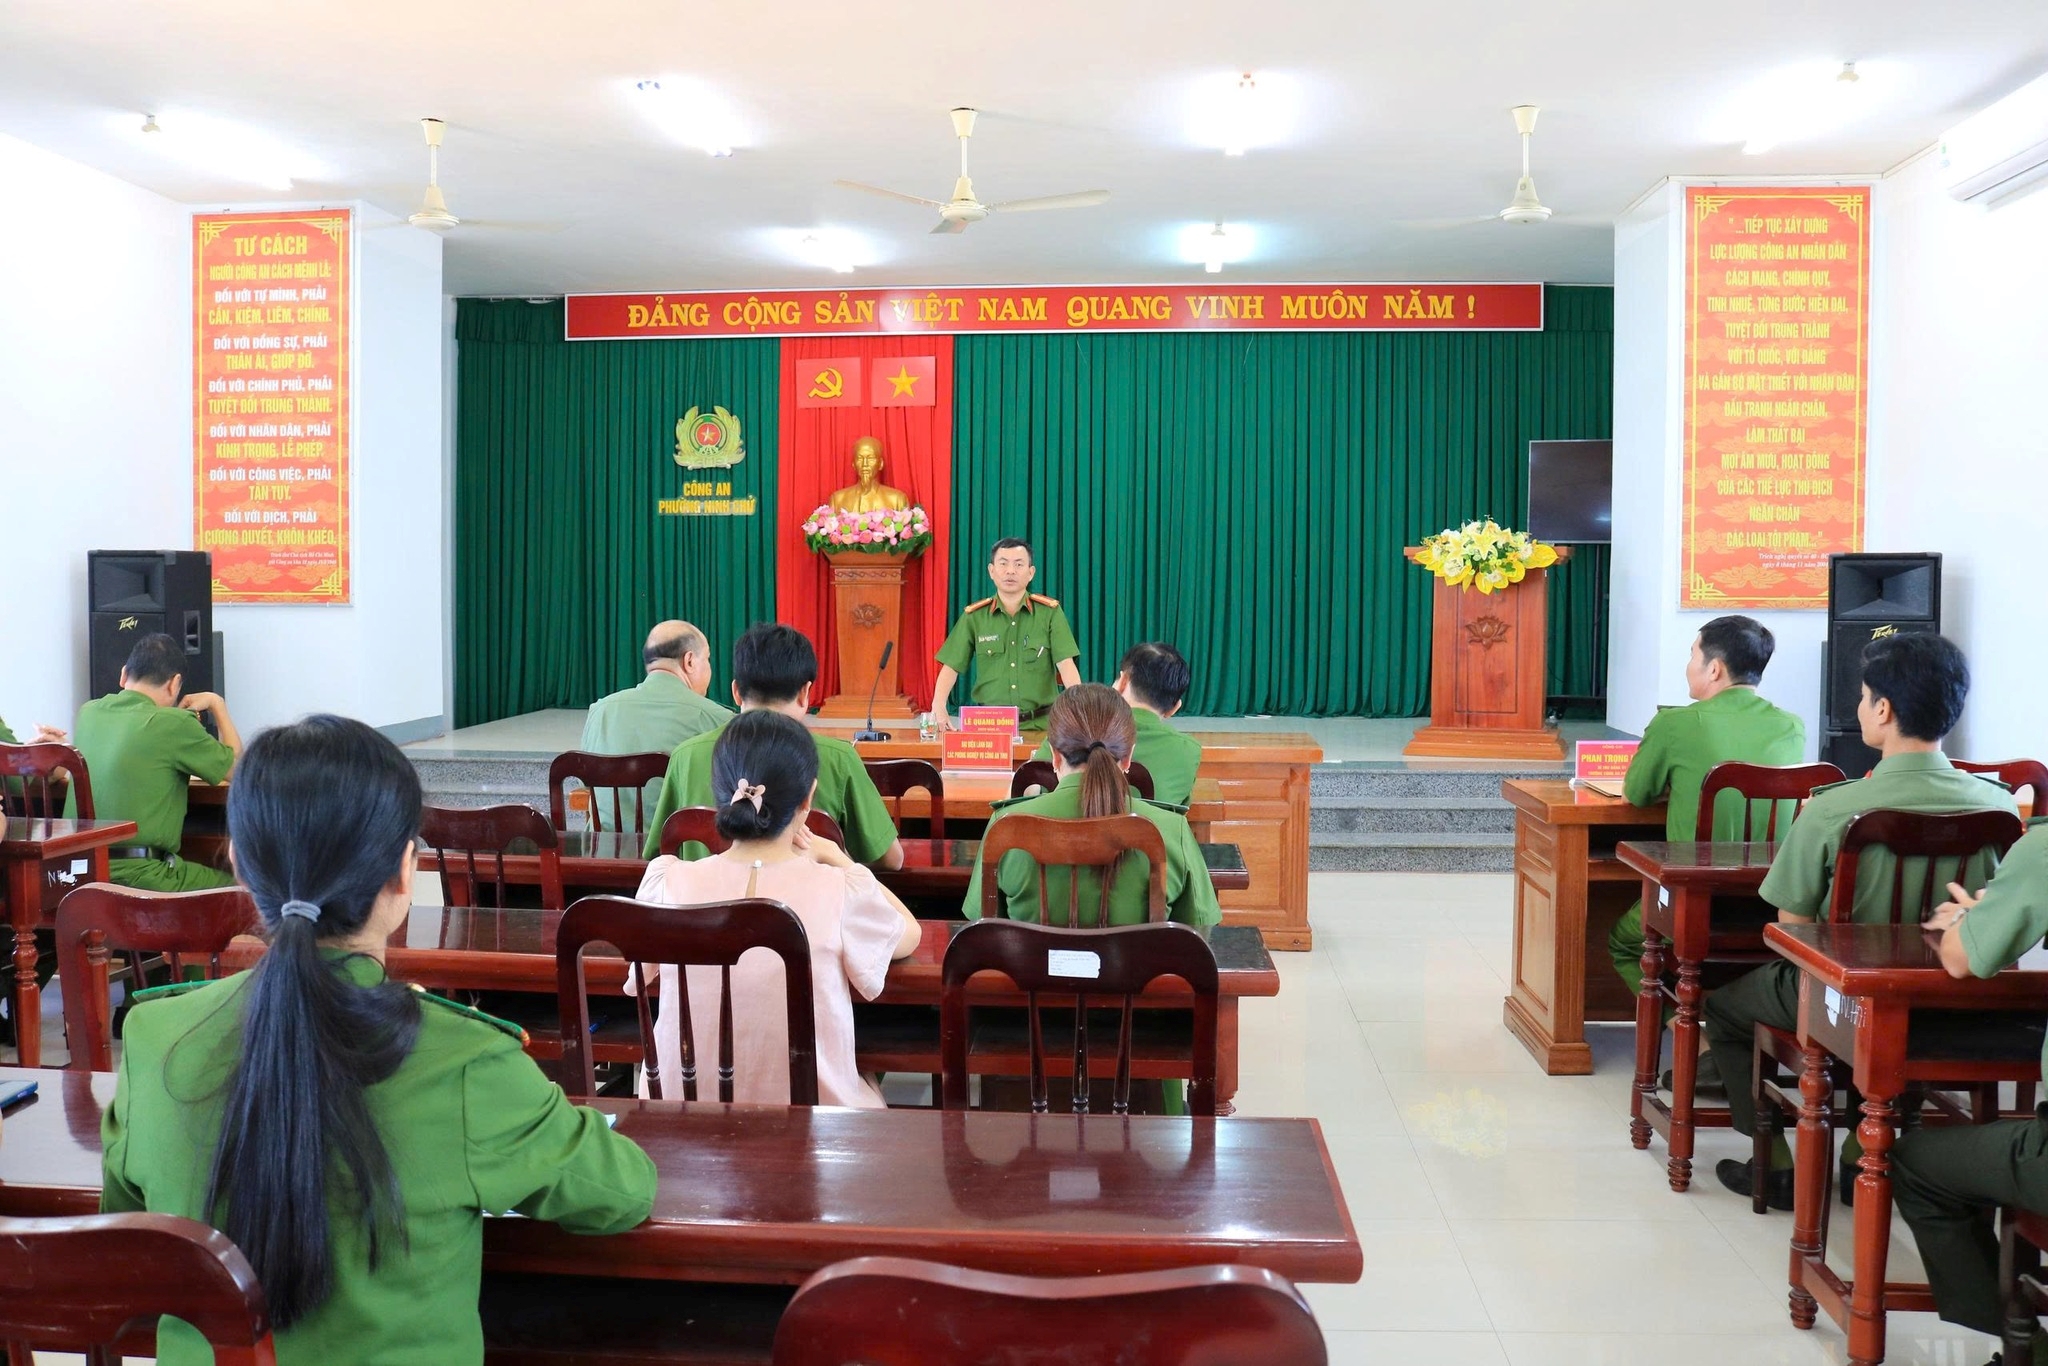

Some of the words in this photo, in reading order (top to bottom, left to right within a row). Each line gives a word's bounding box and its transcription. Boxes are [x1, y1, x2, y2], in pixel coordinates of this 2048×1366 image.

[1766, 218, 1782, 237] TỤC
[1784, 215, 1802, 234] XÂY
[1804, 217, 1828, 237] DỰNG
[234, 235, 257, 256] TƯ
[260, 233, 307, 255] CÁCH
[1710, 243, 1727, 263] LỰC
[1729, 243, 1758, 263] LƯỢNG
[1760, 241, 1784, 260] CÔNG
[1786, 244, 1799, 260] AN
[1801, 241, 1826, 260] NHÂN
[1828, 240, 1847, 260] DÂN
[210, 262, 233, 280] NGƯỜI
[235, 262, 256, 280] CÔNG
[259, 265, 270, 279] AN
[272, 261, 292, 279] CÁCH
[294, 260, 317, 281] MỆNH
[1725, 267, 1749, 286] CÁCH
[1783, 267, 1810, 286] CHÍNH
[215, 286, 232, 303] ĐỐI
[235, 287, 251, 302] VỚI
[254, 288, 268, 304] TỰ
[269, 286, 299, 302] MÌNH,
[302, 284, 326, 301] PHẢI
[1707, 296, 1727, 312] TINH
[1758, 293, 1780, 312] TỪNG
[1783, 293, 1806, 312] BƯỚC
[1808, 294, 1829, 316] HIỆN
[209, 305, 232, 325] CẦN,
[236, 306, 264, 327] KIỆM,
[267, 305, 295, 325] LIÊM,
[298, 303, 332, 322] CHÍNH.
[627, 296, 710, 328] ĐẢNG
[722, 295, 801, 332] CỘNG
[814, 292, 875, 325] SẢN
[891, 293, 964, 329] VIỆT
[978, 298, 1048, 322] NAM
[1066, 295, 1172, 327] QUANG
[1185, 295, 1265, 320] VINH
[1280, 289, 1368, 320] MUÔN
[1383, 289, 1455, 320] NĂM
[1725, 320, 1750, 342] TUYỆT
[1753, 318, 1768, 338] ĐỐI
[1770, 323, 1799, 338] TRUNG
[1801, 320, 1830, 338] THÀNH
[213, 334, 230, 350] ĐỐI
[234, 334, 250, 349] VỚI
[252, 333, 280, 349] ĐỒNG
[283, 335, 300, 351] SỰ,
[303, 332, 327, 348] PHẢI
[226, 351, 252, 370] THÂN
[271, 351, 295, 369] GIÚP
[1728, 346, 1743, 364] VỚI
[1744, 342, 1756, 364] TỔ
[1758, 344, 1783, 366] QUỐC,
[1786, 345, 1800, 364] VỚI
[1802, 344, 1826, 364] ĐẢNG
[209, 376, 226, 393] ĐỐI
[229, 377, 245, 392] VỚI
[248, 377, 279, 392] CHÍNH
[281, 375, 305, 391] PHỦ,
[308, 375, 332, 391] PHẢI
[1699, 371, 1710, 390] VÀ
[1712, 369, 1730, 390] GẮN
[1732, 372, 1744, 390] BÓ
[1747, 371, 1765, 391] MẬT
[1768, 370, 1791, 390] THIẾT
[1794, 372, 1807, 390] VỚI
[1810, 371, 1834, 390] NHÂN
[208, 395, 238, 417] TUYỆT
[240, 394, 257, 414] ĐỐI
[260, 398, 293, 413] TRUNG
[297, 394, 333, 413] THÀNH.
[1724, 396, 1742, 416] ĐẤU
[1744, 401, 1772, 417] TRANH
[1775, 399, 1799, 417] NGĂN
[210, 422, 227, 438] ĐỐI
[230, 422, 245, 437] VỚI
[249, 423, 277, 437] NHÂN
[280, 423, 304, 438] DÂN,
[307, 420, 331, 436] PHẢI
[1746, 424, 1765, 442] LÀM
[1767, 422, 1788, 443] THẤT
[1791, 427, 1805, 446] BẠI
[216, 440, 240, 459] KÍNH
[243, 442, 279, 460] TRỌNG,
[282, 437, 294, 458] LỄ
[1721, 453, 1738, 472] MỌI
[1740, 451, 1754, 469] ÂM
[1781, 454, 1803, 472] HOẠT
[1806, 451, 1829, 472] ĐỘNG
[209, 465, 227, 481] ĐỐI
[229, 466, 245, 481] VỚI
[248, 466, 277, 481] CÔNG
[279, 466, 304, 483] VIỆC,
[307, 464, 332, 481] PHẢI
[249, 484, 269, 502] TẬN
[683, 480, 712, 496] CÔNG
[716, 482, 731, 496] AN
[1717, 475, 1735, 495] CỦA
[1737, 476, 1754, 495] CÁC
[1757, 475, 1772, 495] THẾ
[1774, 478, 1791, 498] LỰC
[1794, 477, 1810, 495] THÙ
[1812, 480, 1833, 498] ĐỊCH
[658, 497, 701, 514] PHƯỜNG
[704, 500, 730, 514] NINH
[1749, 503, 1774, 521] NGĂN
[1776, 504, 1800, 524] CHẶN
[224, 507, 241, 523] ĐỐI
[244, 509, 260, 523] VỚI
[263, 511, 290, 526] ĐỊCH,
[293, 507, 317, 523] PHẢI
[205, 528, 239, 545] CƯƠNG
[276, 528, 305, 544] KHÔN
[1727, 528, 1744, 547] CÁC
[1746, 531, 1766, 550] LOẠI
[1768, 529, 1781, 550] TỘI
[1581, 754, 1602, 763] PHAN
[1604, 754, 1629, 764] TRỌNG
